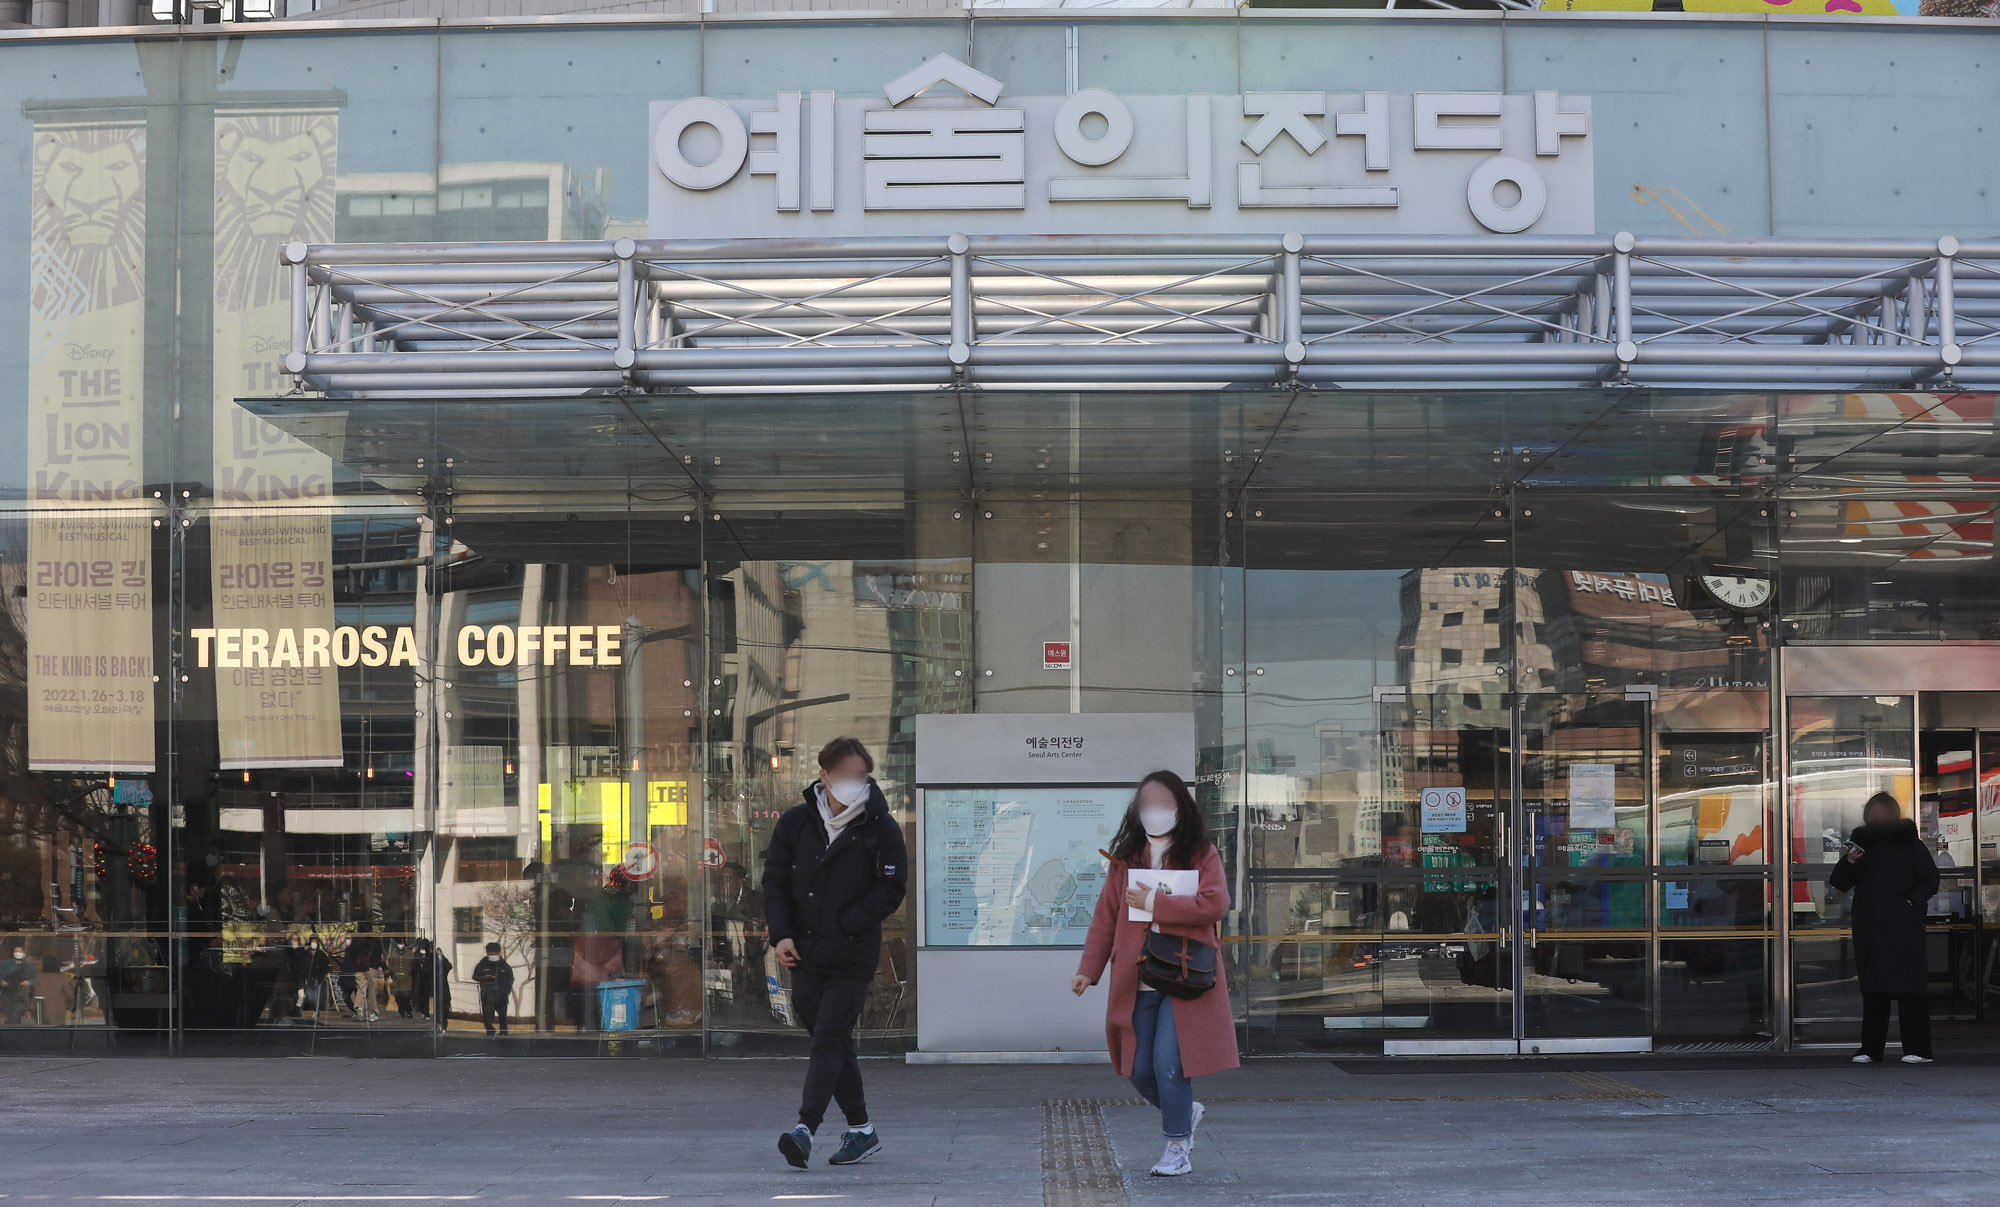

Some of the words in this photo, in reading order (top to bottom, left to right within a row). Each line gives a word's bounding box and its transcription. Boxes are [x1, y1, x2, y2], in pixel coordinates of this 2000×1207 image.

[654, 52, 1589, 234] 예술의전당
[250, 335, 291, 354] Disne
[58, 368, 121, 398] THE
[46, 413, 130, 464] LION
[35, 470, 139, 502] KING
[221, 465, 325, 504] KING
[37, 521, 57, 530] THE
[59, 521, 149, 531] AWARD-WINNING
[219, 527, 237, 537] THE
[239, 526, 326, 537] AWARD-WINNING
[58, 532, 83, 542] BEST
[84, 532, 129, 542] MUSICAL
[239, 537, 262, 546] BEST
[263, 536, 308, 546] MUSICAL
[36, 559, 114, 588] 라이온
[121, 559, 147, 588] 킹
[219, 562, 295, 590] 라이온
[302, 560, 325, 588] 킹
[37, 592, 113, 611] 인터내셔널
[115, 592, 147, 611] 투어
[221, 593, 294, 612] 인터내셔널
[297, 592, 326, 610] 투어
[191, 625, 420, 668] TERAROSA
[457, 625, 622, 667] COFFEE
[1047, 649, 1067, 658] 에스원
[34, 655, 59, 678] THE
[62, 656, 92, 678] KING
[95, 656, 108, 678] IS
[111, 656, 152, 678] BACK!
[232, 667, 266, 688] 이런
[270, 667, 323, 687] 공연은
[43, 689, 145, 703] 2022.1.26~3.18
[43, 704, 91, 716] 예술의전당
[93, 704, 145, 716] 오페라극장
[1026, 737, 1085, 749] 예술의전당
[1028, 751, 1046, 759] Seoul
[1046, 751, 1060, 759] Arts
[1061, 751, 1082, 759] Center
